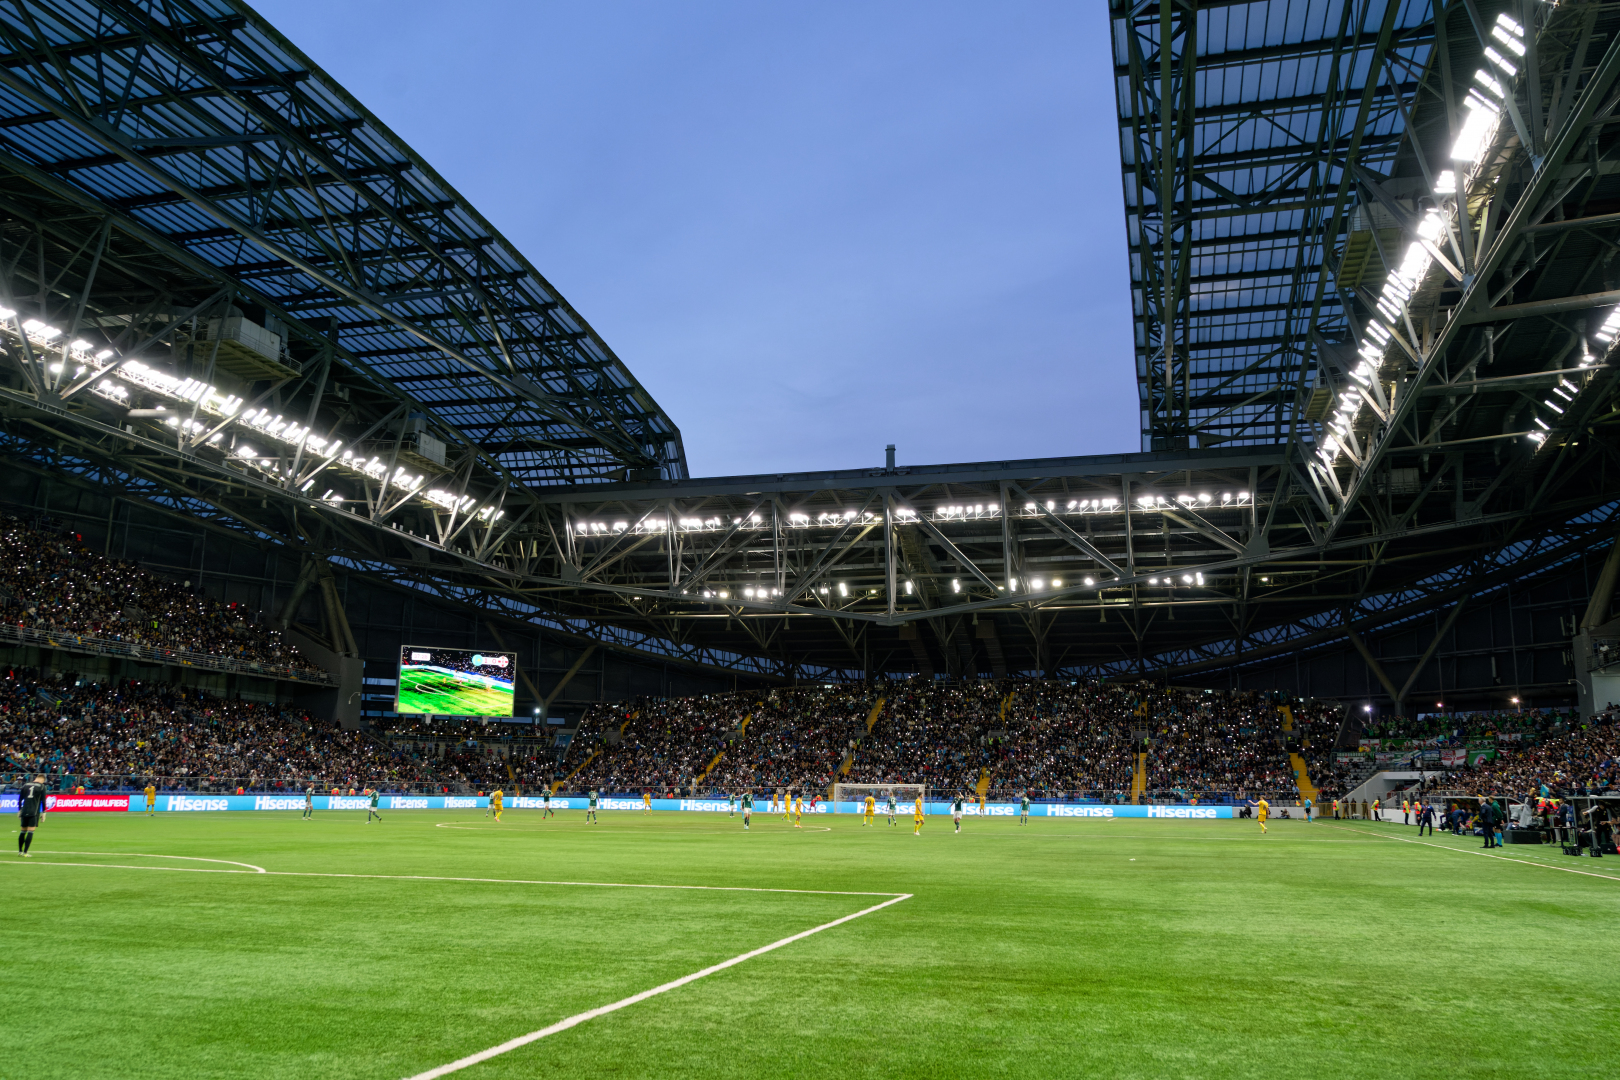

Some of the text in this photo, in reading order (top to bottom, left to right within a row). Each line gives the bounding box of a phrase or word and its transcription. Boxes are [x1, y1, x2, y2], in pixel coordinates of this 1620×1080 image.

[27, 786, 34, 798] 1
[57, 799, 128, 808] EUROPEAN QUALIFIERS
[167, 796, 228, 811] Hisense
[254, 796, 306, 810] Hisense
[328, 796, 371, 810] Hisense
[390, 797, 428, 809] Hisense
[444, 797, 477, 808] Hisense
[1047, 804, 1113, 817] Hisense
[1147, 805, 1217, 818] Hisense
